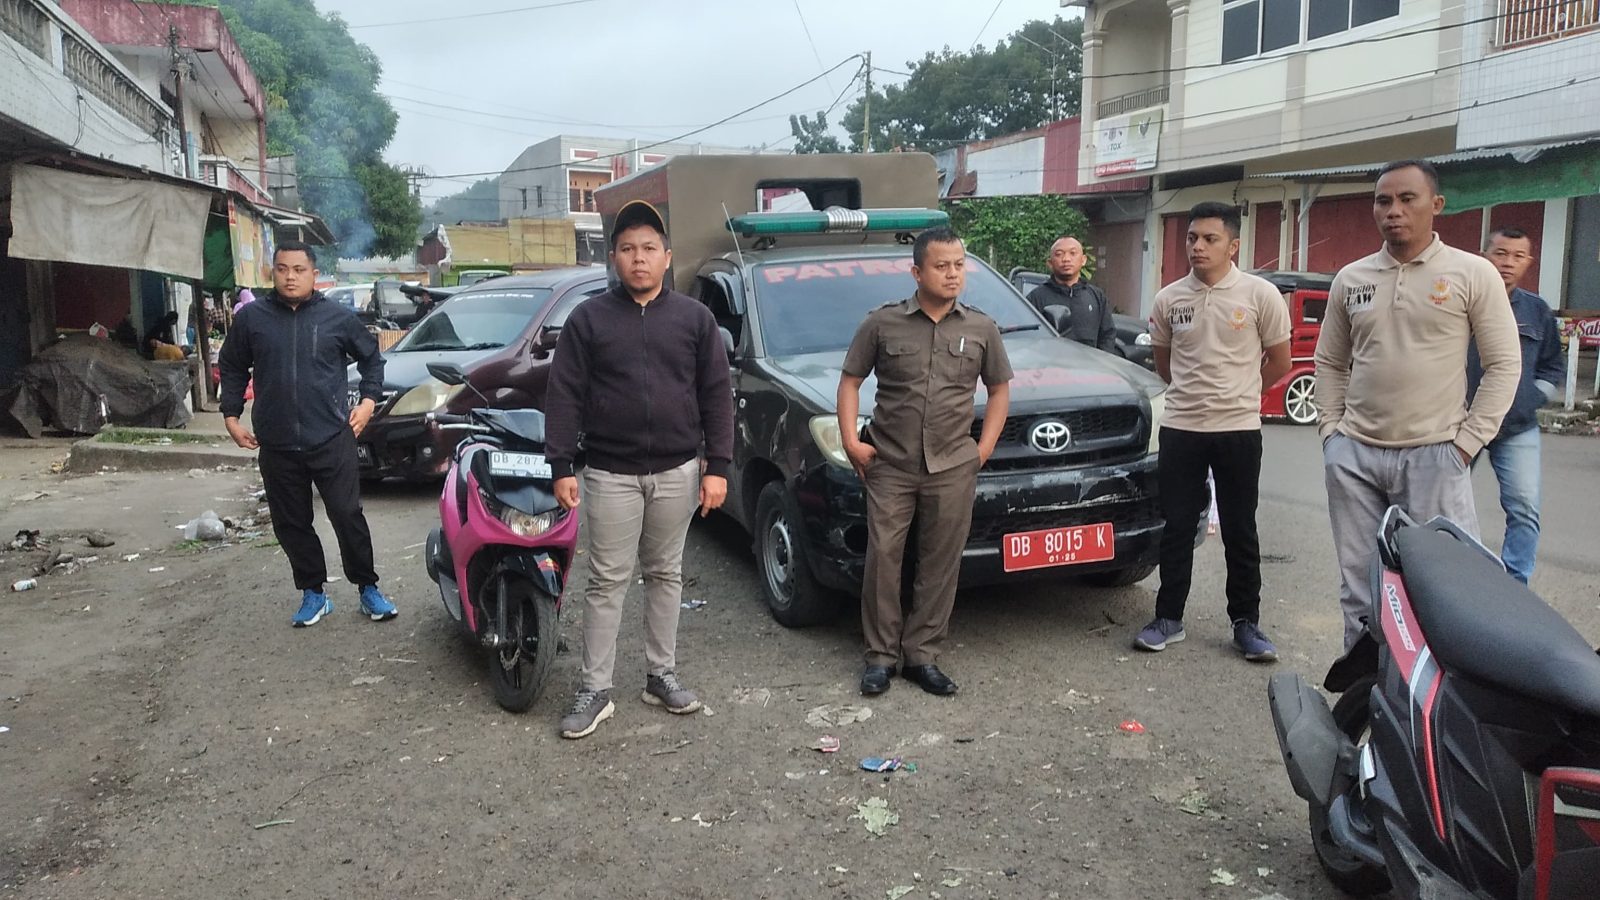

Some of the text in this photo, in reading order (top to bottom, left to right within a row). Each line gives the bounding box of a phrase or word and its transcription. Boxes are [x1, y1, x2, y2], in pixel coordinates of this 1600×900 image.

[1347, 284, 1378, 295] REGION
[1345, 293, 1375, 307] LAW
[1168, 305, 1195, 316] REGION
[1169, 314, 1194, 325] LAW
[494, 453, 509, 464] DB
[1011, 526, 1106, 557] DB 8015 K
